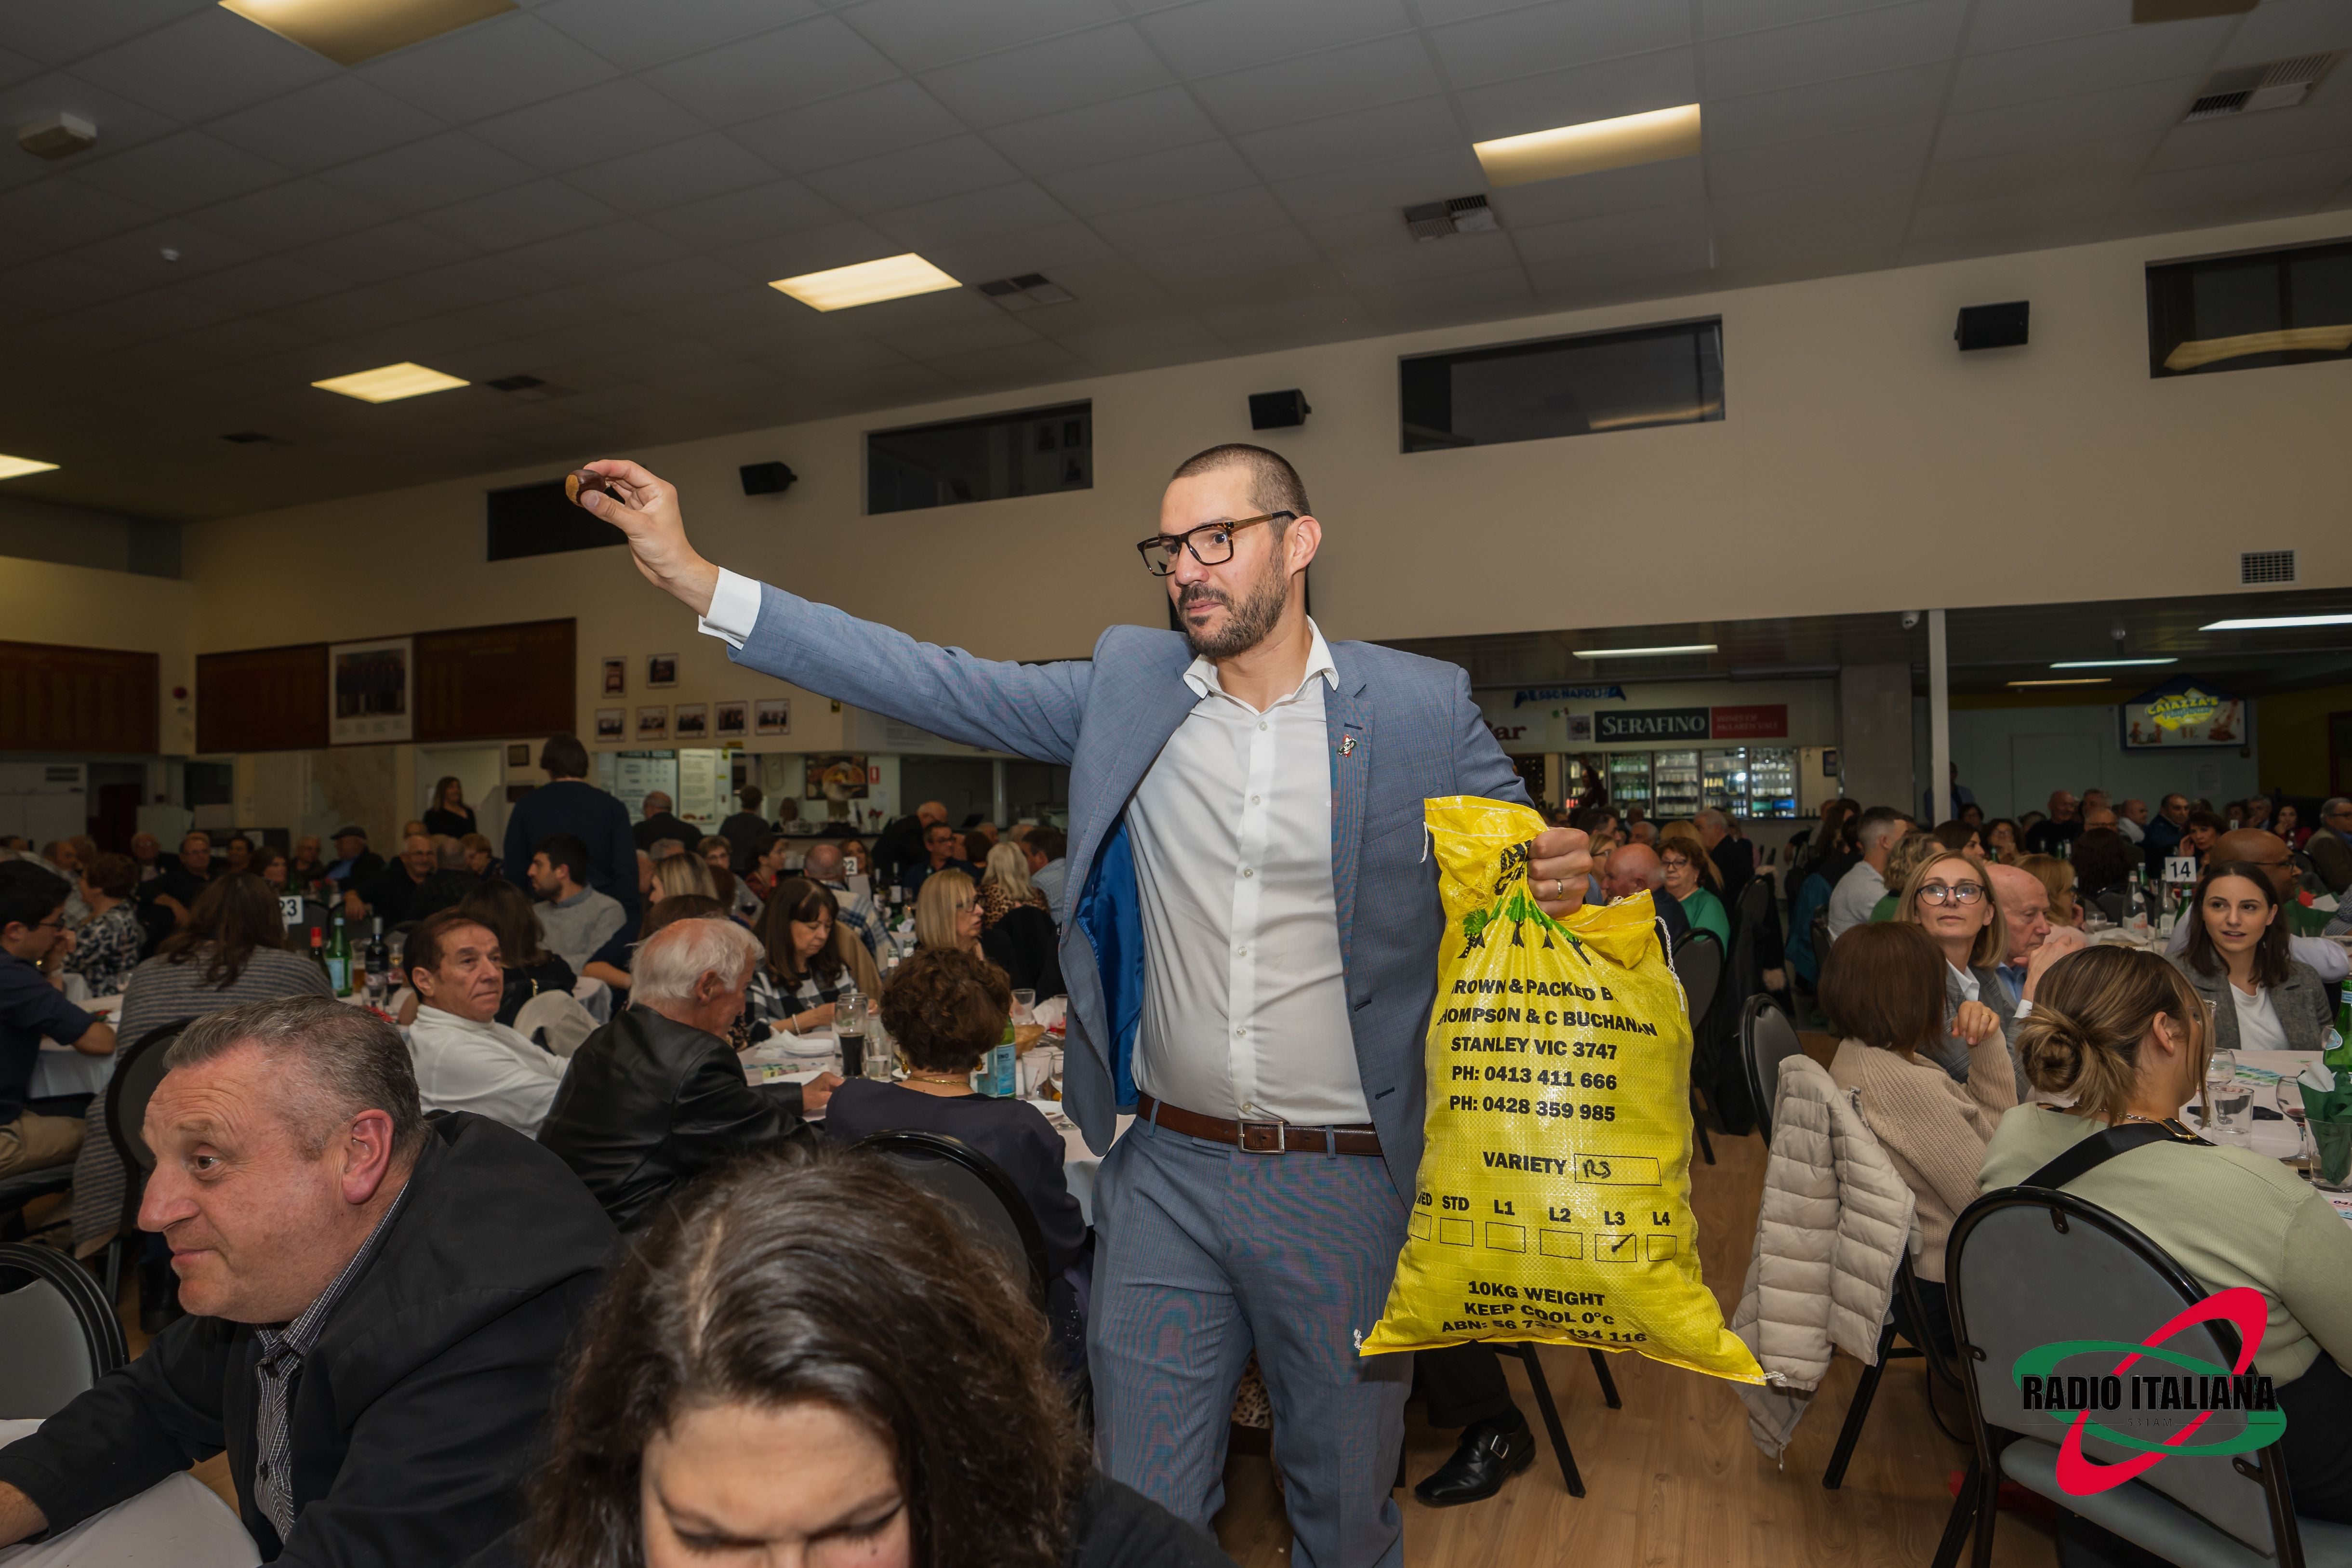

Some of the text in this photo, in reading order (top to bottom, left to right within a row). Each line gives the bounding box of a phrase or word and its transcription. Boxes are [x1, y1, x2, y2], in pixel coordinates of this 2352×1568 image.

[1484, 720, 1527, 740] ar
[2170, 861, 2191, 878] 14
[1451, 978, 1619, 1002] ROWN & PACKED B
[1436, 1007, 1658, 1036] HOMPSON & C BUCHANAN
[1450, 1036, 1618, 1060] STANLEY VIC 3747
[1452, 1065, 1617, 1090] PH: 0413 411 666
[1449, 1095, 1616, 1122] PH: 0428 359 985
[1482, 1151, 1567, 1175] VARIETY
[1441, 1196, 1470, 1211] STD
[1494, 1199, 1515, 1216] L1
[1549, 1207, 1571, 1223] L2
[1604, 1210, 1626, 1226] L3
[1652, 1211, 1671, 1226] L4
[1468, 1280, 1606, 1306] 10KG WEIGHT
[1464, 1302, 1515, 1316] KEEP
[1520, 1304, 1577, 1324] COOL
[1442, 1319, 1488, 1333] ABN:
[1492, 1320, 1517, 1329] 56
[1609, 1332, 1648, 1343] 116
